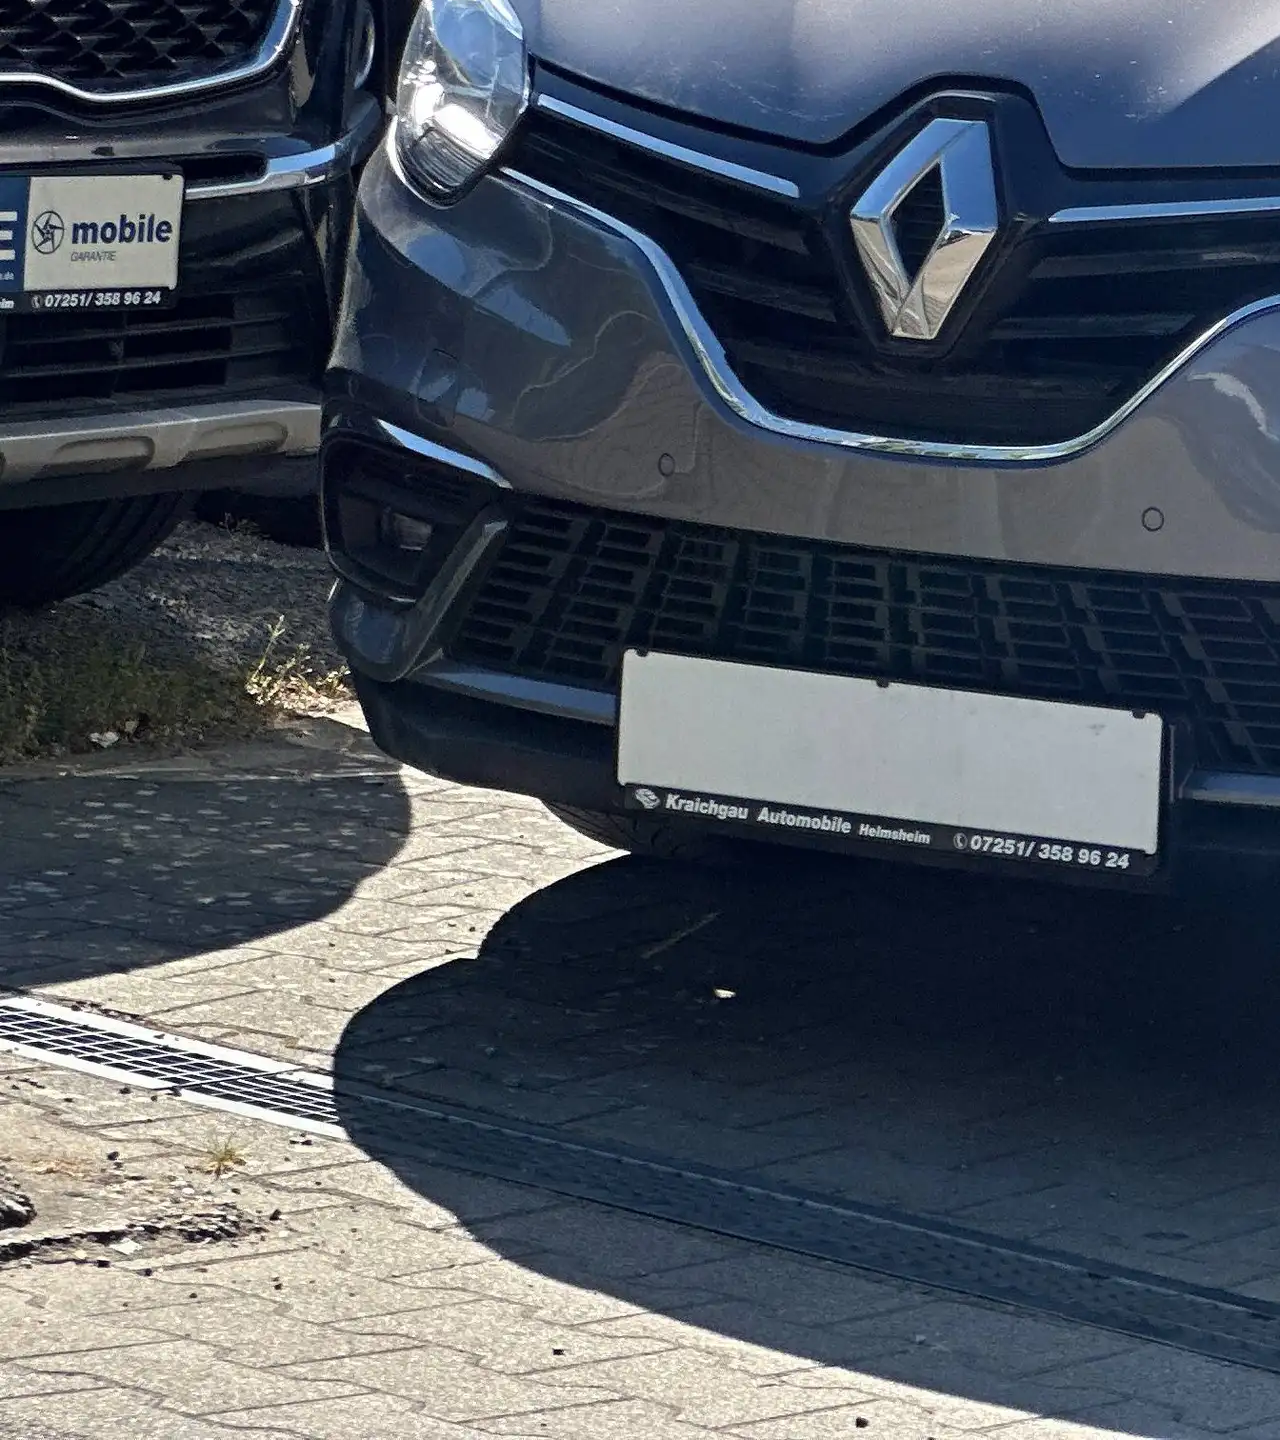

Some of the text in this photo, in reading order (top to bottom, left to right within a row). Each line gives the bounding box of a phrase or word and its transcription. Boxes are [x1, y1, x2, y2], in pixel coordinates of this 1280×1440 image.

[72, 214, 173, 245] mobile
[70, 250, 117, 262] GARANTIE
[44, 291, 161, 308] 07251/ 358 96 24
[665, 793, 748, 820] Kraichgau
[756, 806, 852, 835] Automobile
[970, 834, 1037, 858] 07251/
[1038, 843, 1073, 863] 358
[1077, 848, 1101, 866] 96
[1105, 851, 1130, 870] 24
